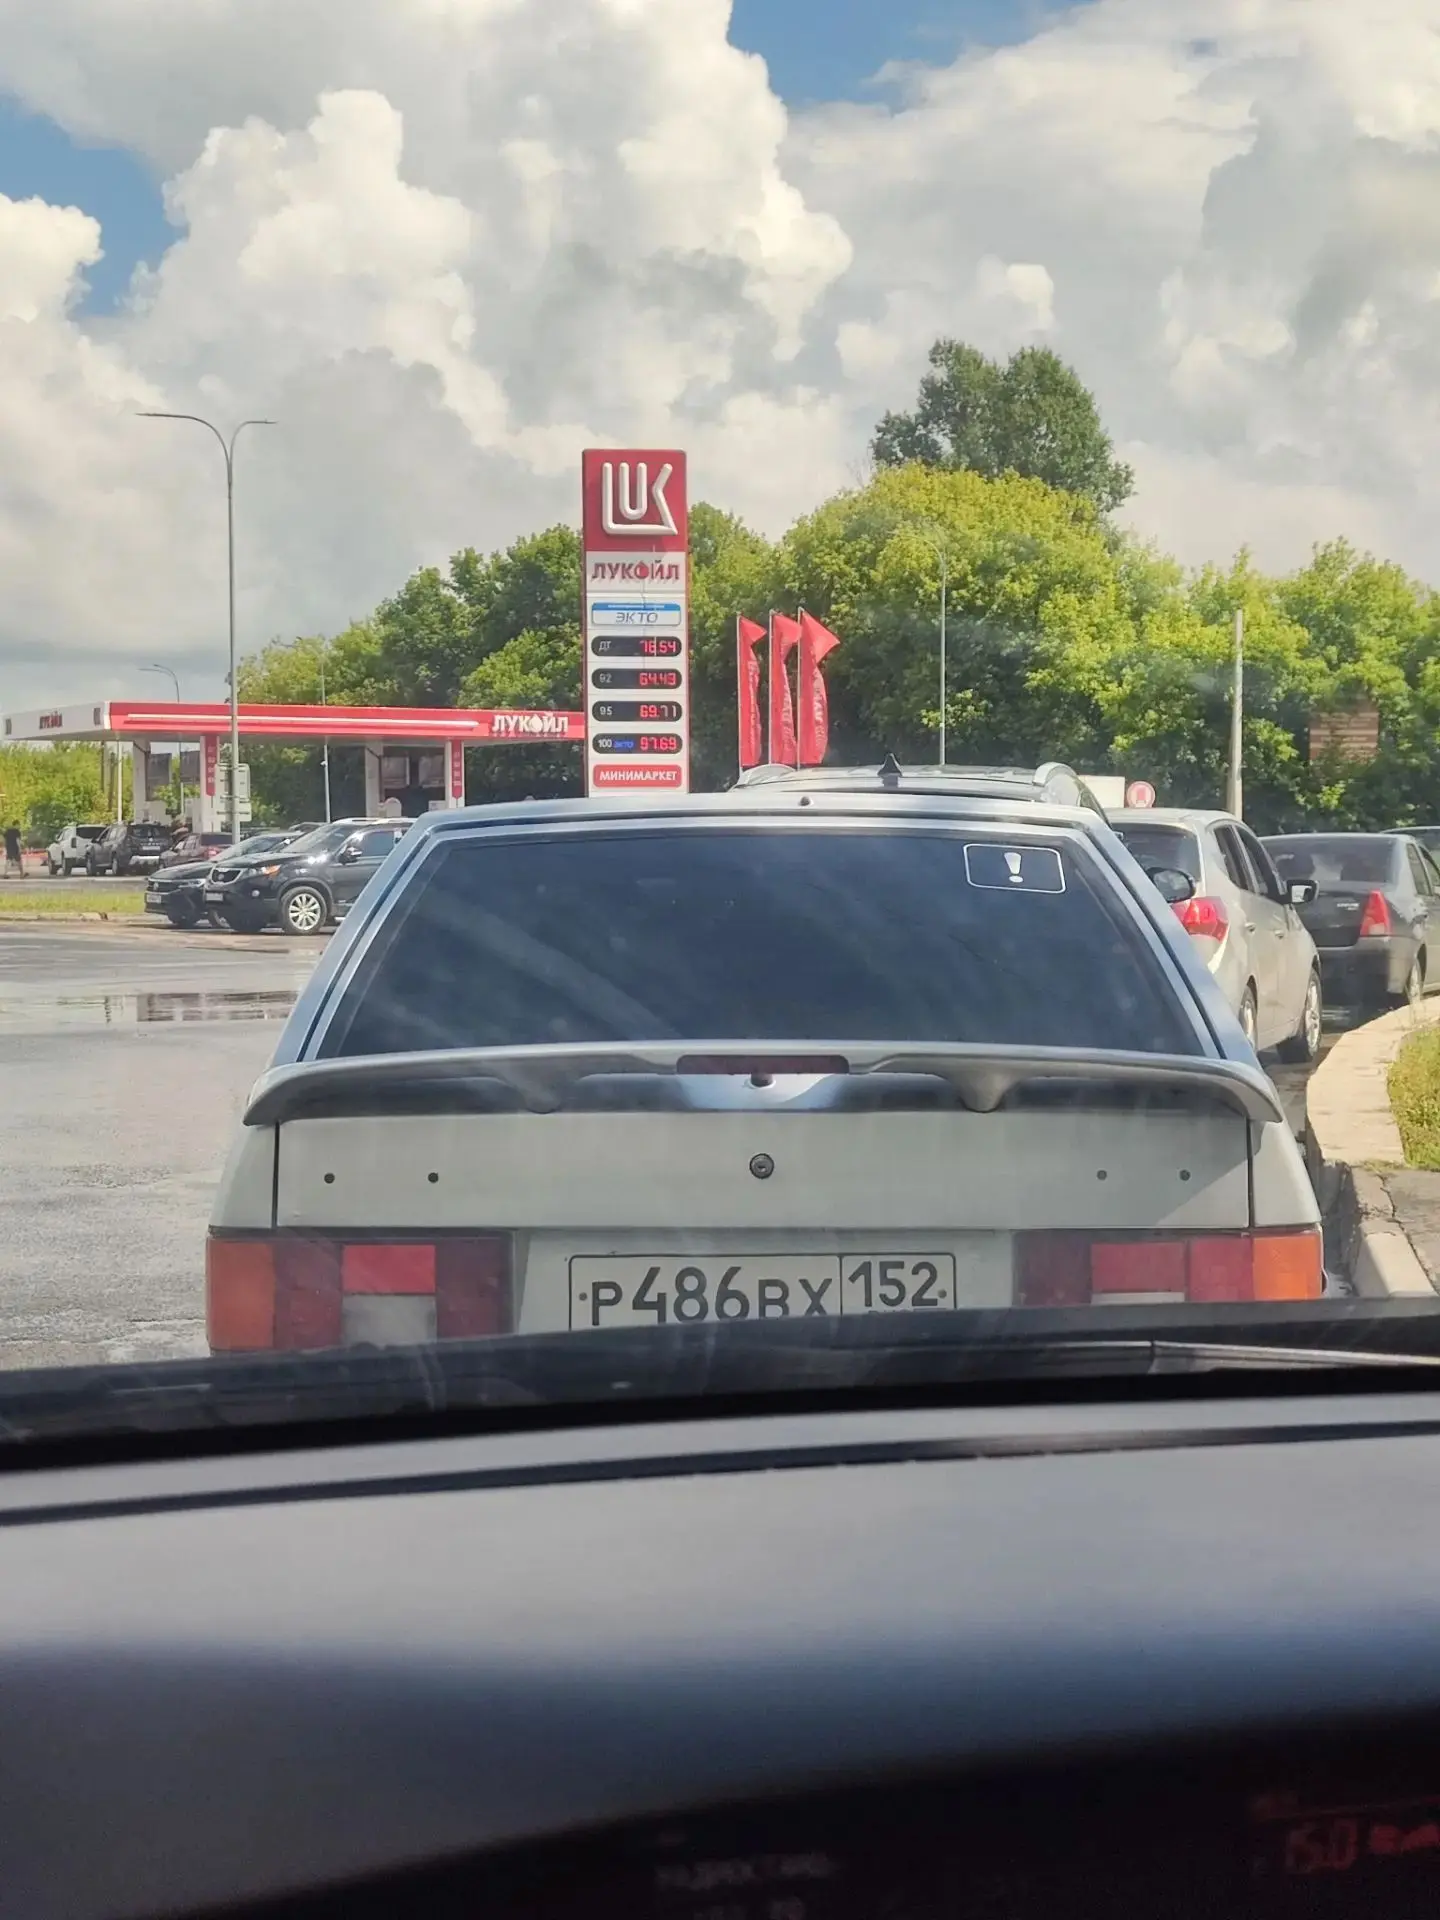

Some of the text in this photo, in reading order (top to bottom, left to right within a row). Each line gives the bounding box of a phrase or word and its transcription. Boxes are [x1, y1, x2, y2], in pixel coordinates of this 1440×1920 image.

[592, 560, 680, 580] ЛУКОЙЛ
[616, 612, 658, 624] ЭКТО
[600, 673, 612, 683] 92
[600, 706, 612, 716] 95
[492, 712, 569, 733] ЛУКОЙЛ
[598, 738, 613, 748] 100
[600, 770, 677, 781] МИНИМАРКЕТ
[848, 1261, 938, 1307] 152
